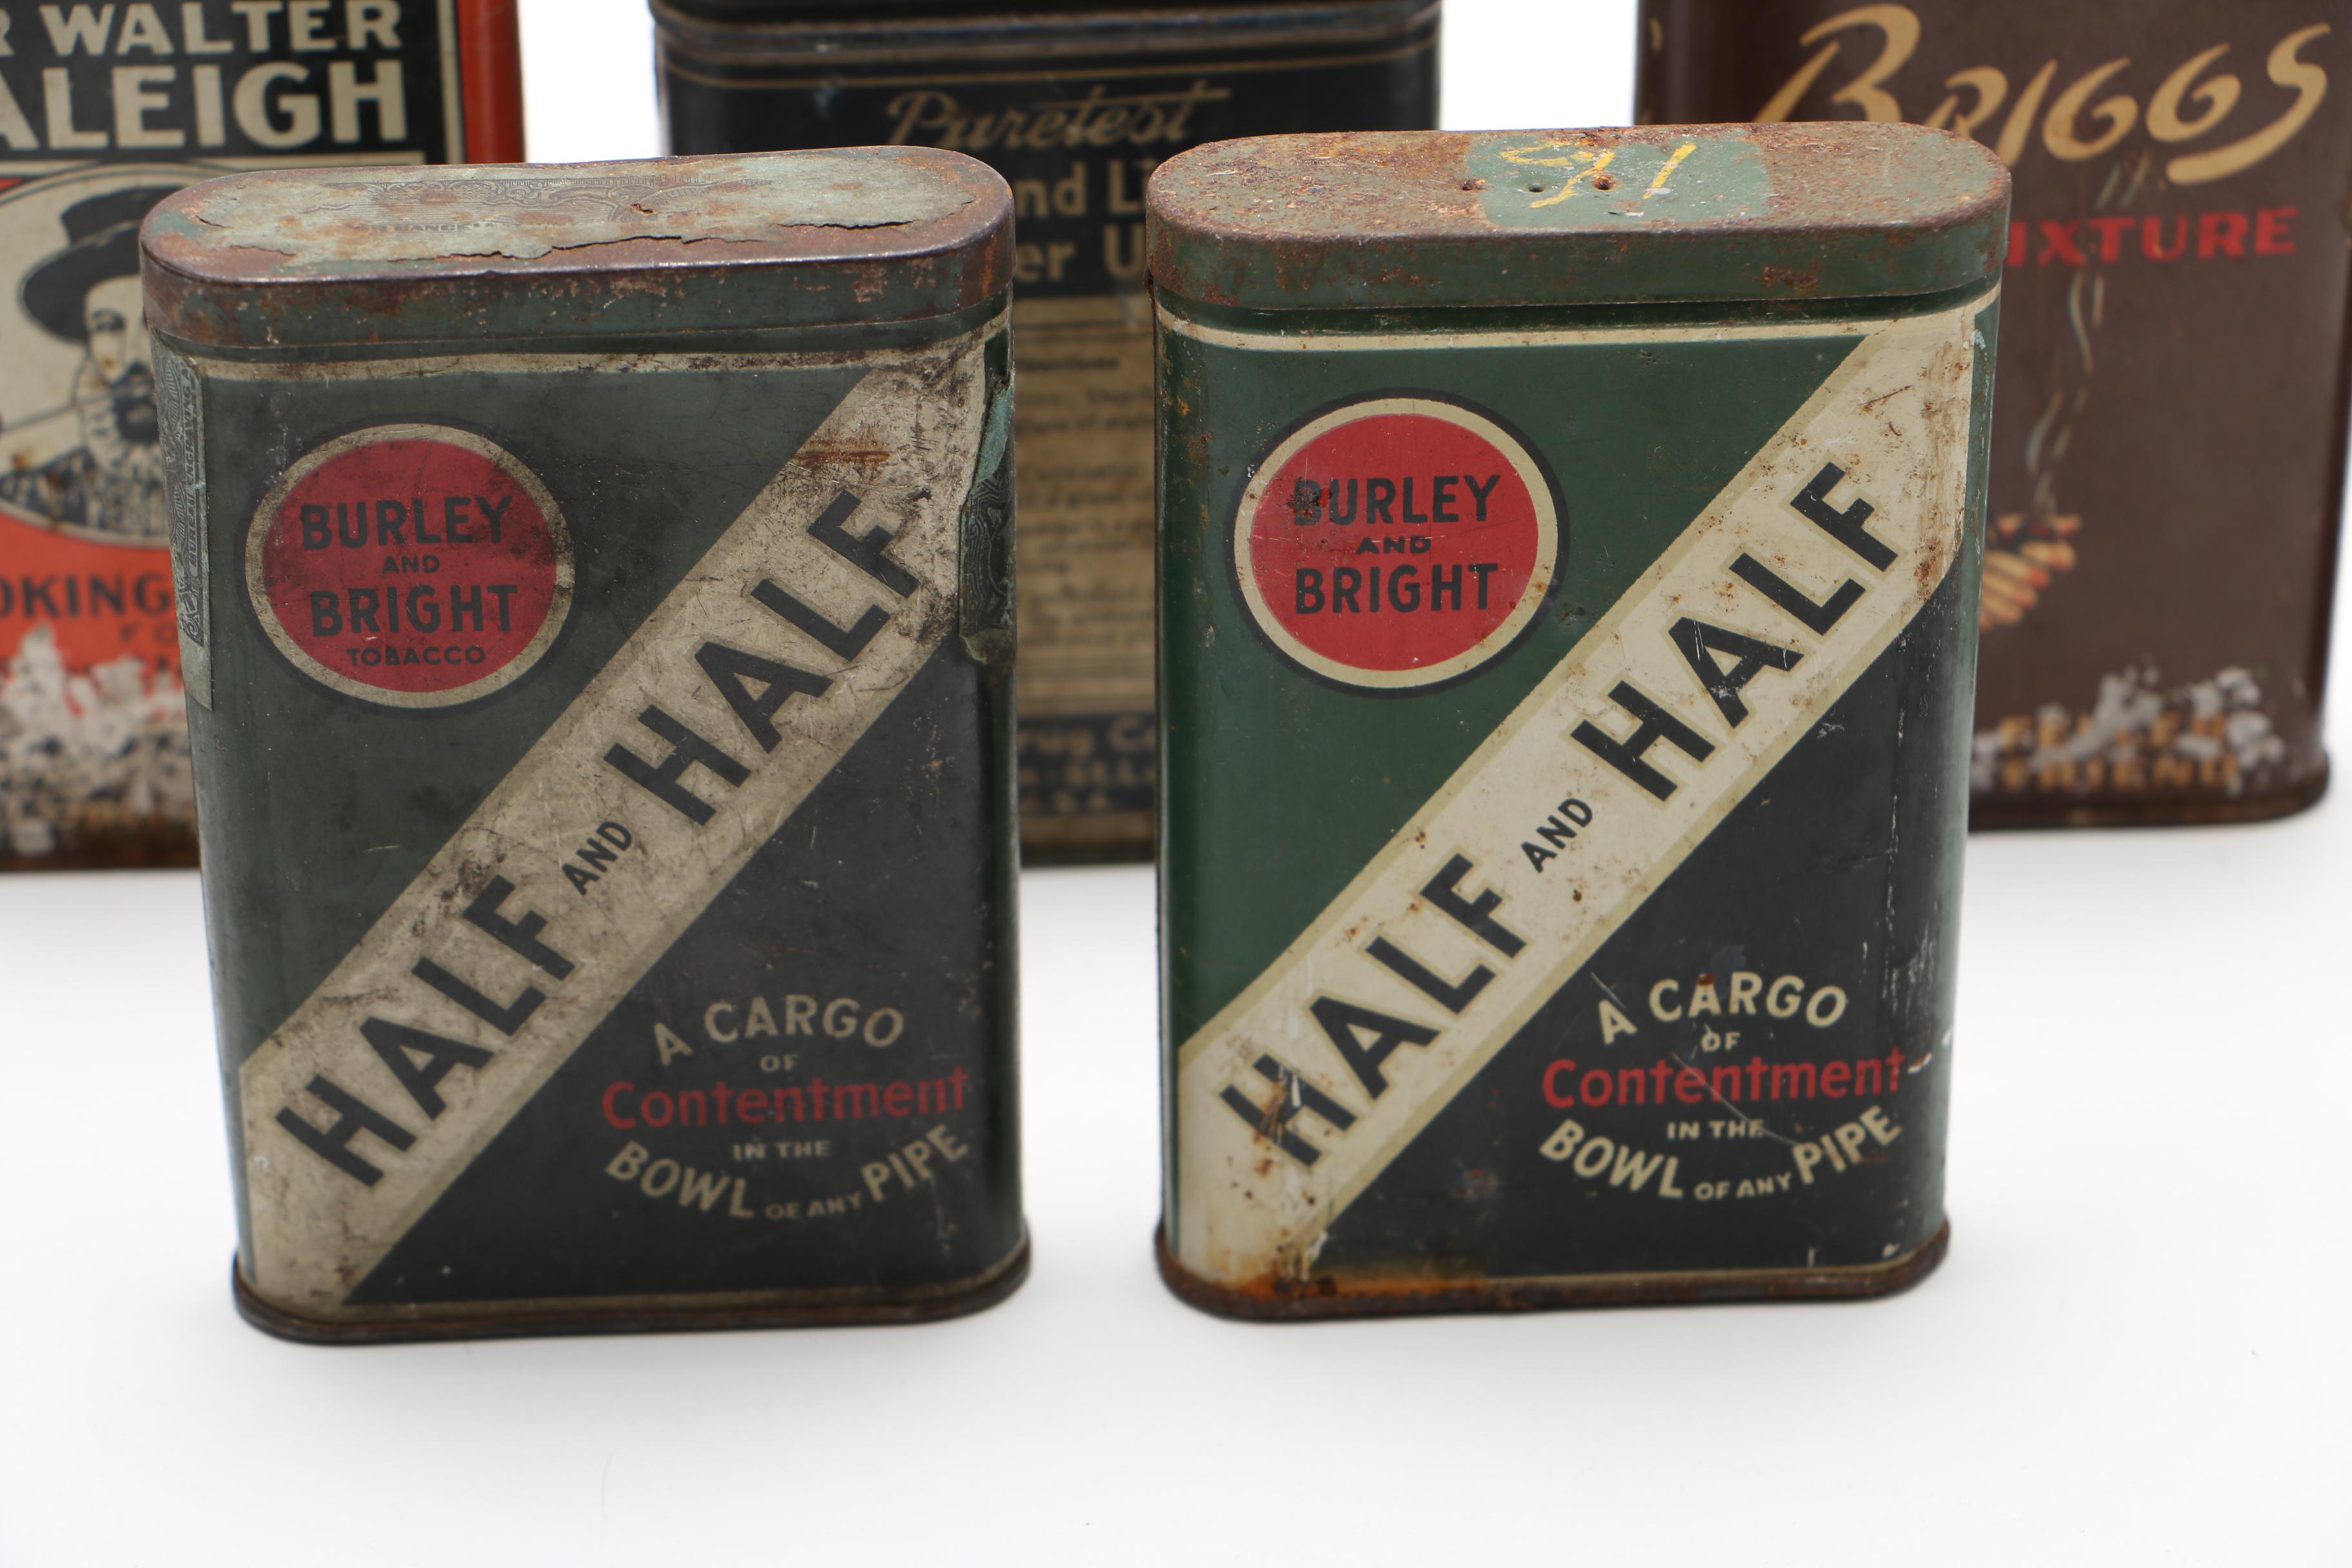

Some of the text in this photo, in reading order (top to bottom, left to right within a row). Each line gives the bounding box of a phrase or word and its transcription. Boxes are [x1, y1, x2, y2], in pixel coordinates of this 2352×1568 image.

[39, 0, 403, 56] WALTER
[886, 77, 1232, 150] Puretest
[300, 495, 514, 551] BURLEY
[1291, 475, 1502, 526] BURLEY
[382, 554, 441, 574] AND
[1355, 535, 1432, 555] AND
[309, 584, 518, 638] BRIGHT
[1295, 562, 1499, 614] BRIGHT
[346, 645, 487, 667] TOBACCO
[274, 488, 920, 1188] HALF AND HALF
[1220, 461, 1899, 1167] HALF AND HALF
[653, 994, 904, 1066] A CARGO
[1598, 971, 1848, 1045] A CARGO
[760, 1054, 799, 1072] OF
[1700, 1031, 1741, 1052] OF
[602, 1066, 970, 1130] Contentment
[1542, 1046, 1906, 1108] Contentment
[733, 1141, 831, 1161] IN THE
[1538, 1105, 1903, 1201] BOWL OF ANY PIPE
[1667, 1119, 1765, 1140] IN THE
[605, 1124, 969, 1220] BOWL OF ANY PIPE
